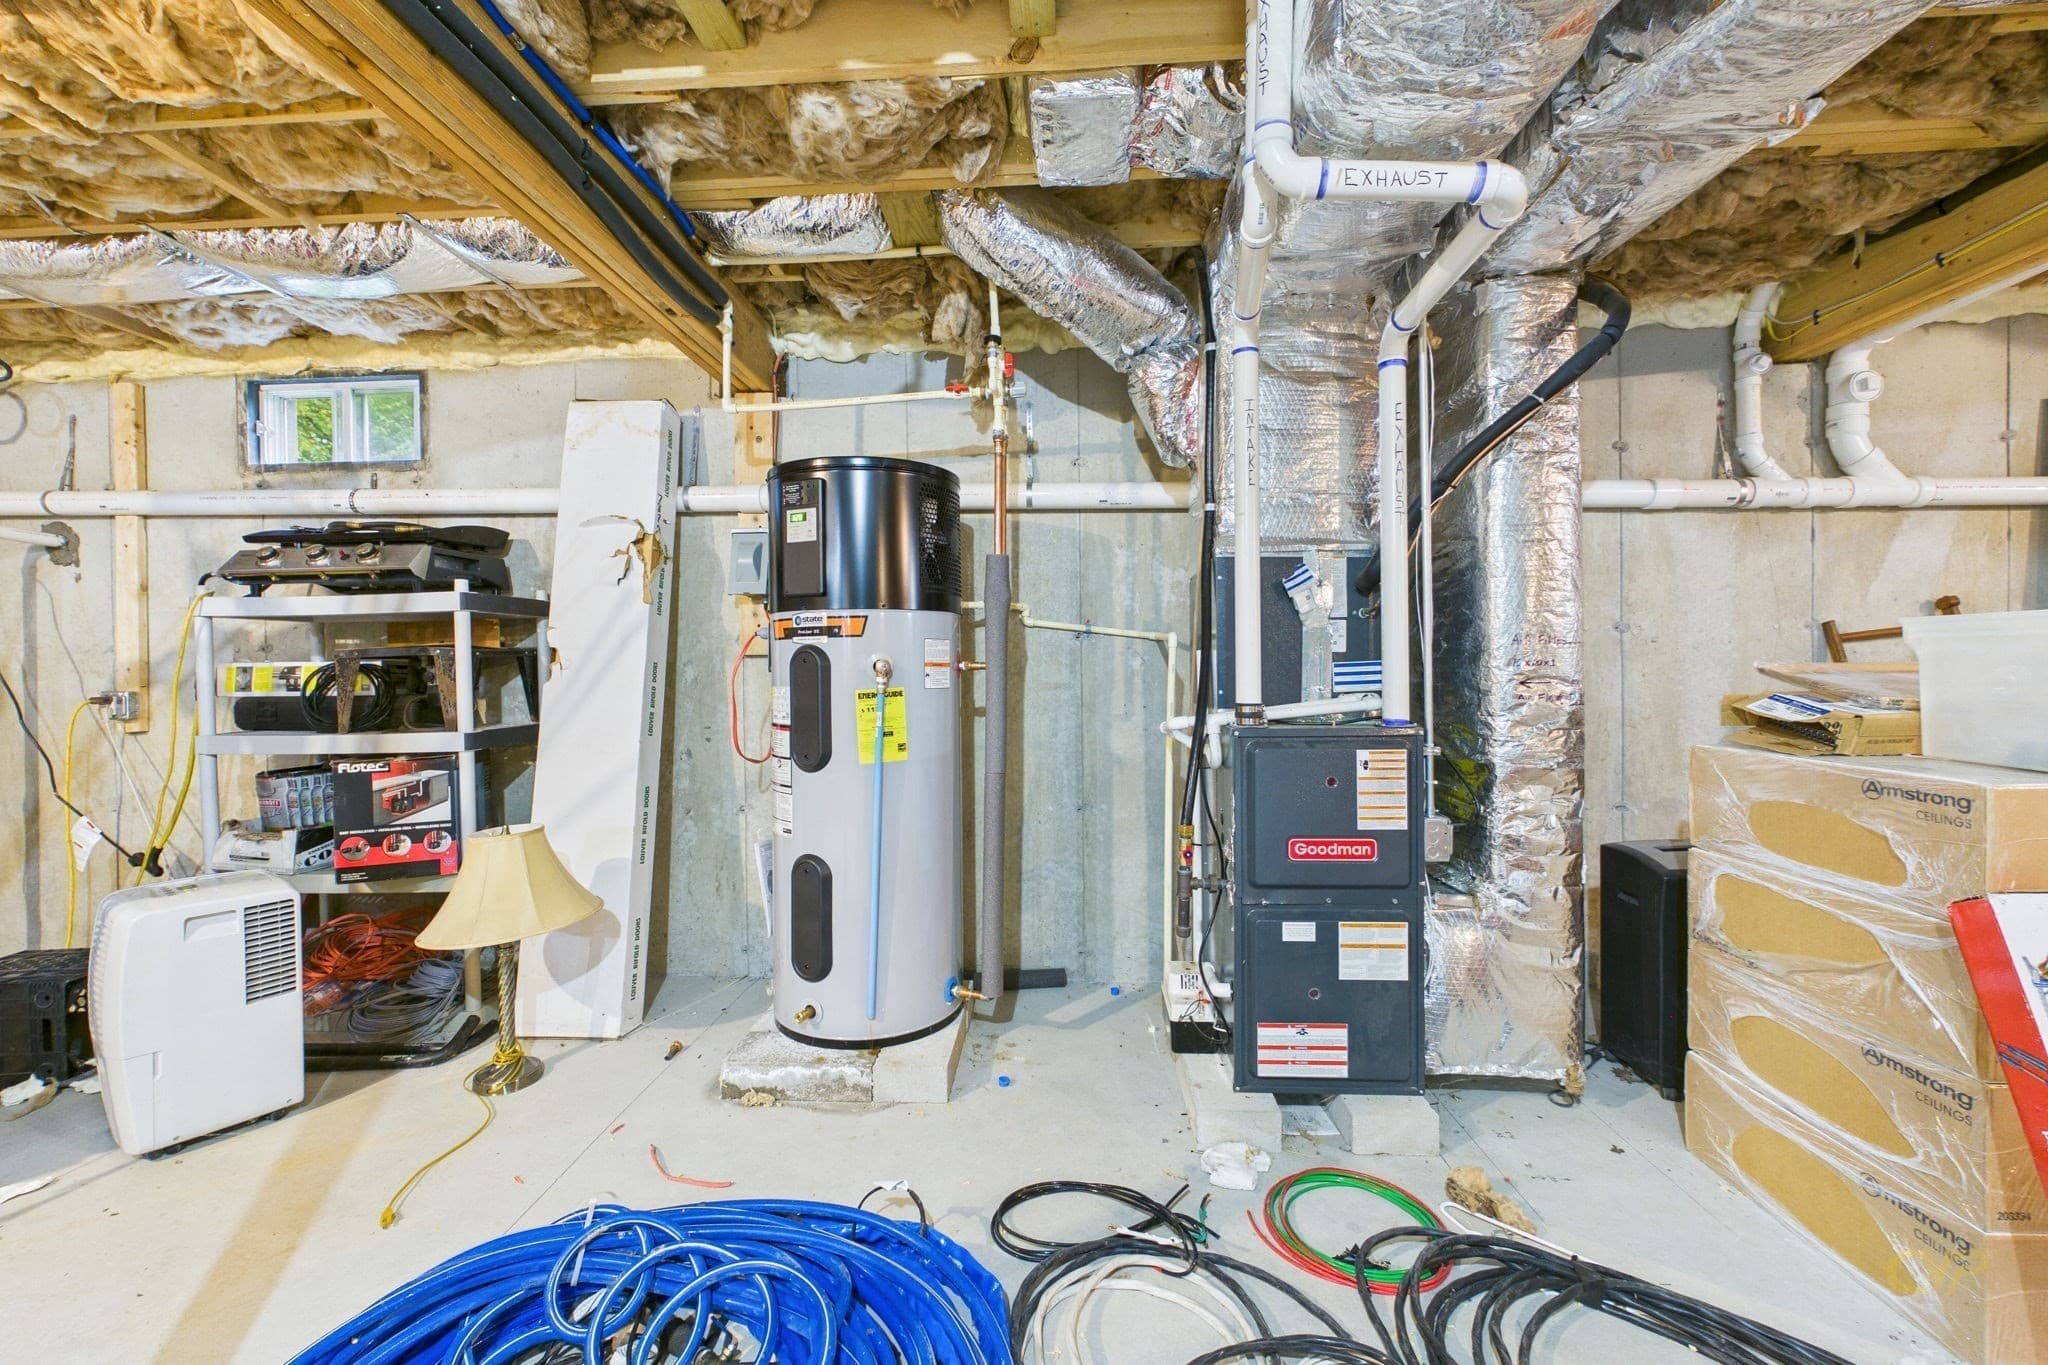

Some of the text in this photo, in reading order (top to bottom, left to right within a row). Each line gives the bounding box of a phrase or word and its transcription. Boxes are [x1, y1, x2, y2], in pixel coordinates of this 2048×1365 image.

[1258, 0, 1270, 96] XHAUST
[1344, 167, 1448, 188] EXHAUST
[1243, 398, 1256, 486] INTAKE
[1394, 402, 1405, 518] EXHAUST
[802, 615, 823, 623] state
[647, 711, 655, 737] LOUVER
[1861, 778, 1972, 814] Armstrong
[1915, 809, 1973, 830] CEILINGS
[1293, 842, 1372, 856] Goodman
[630, 973, 638, 1001] LOUVER
[1861, 1041, 1974, 1111] Armstrong
[1914, 1090, 1973, 1127] CEILINGS
